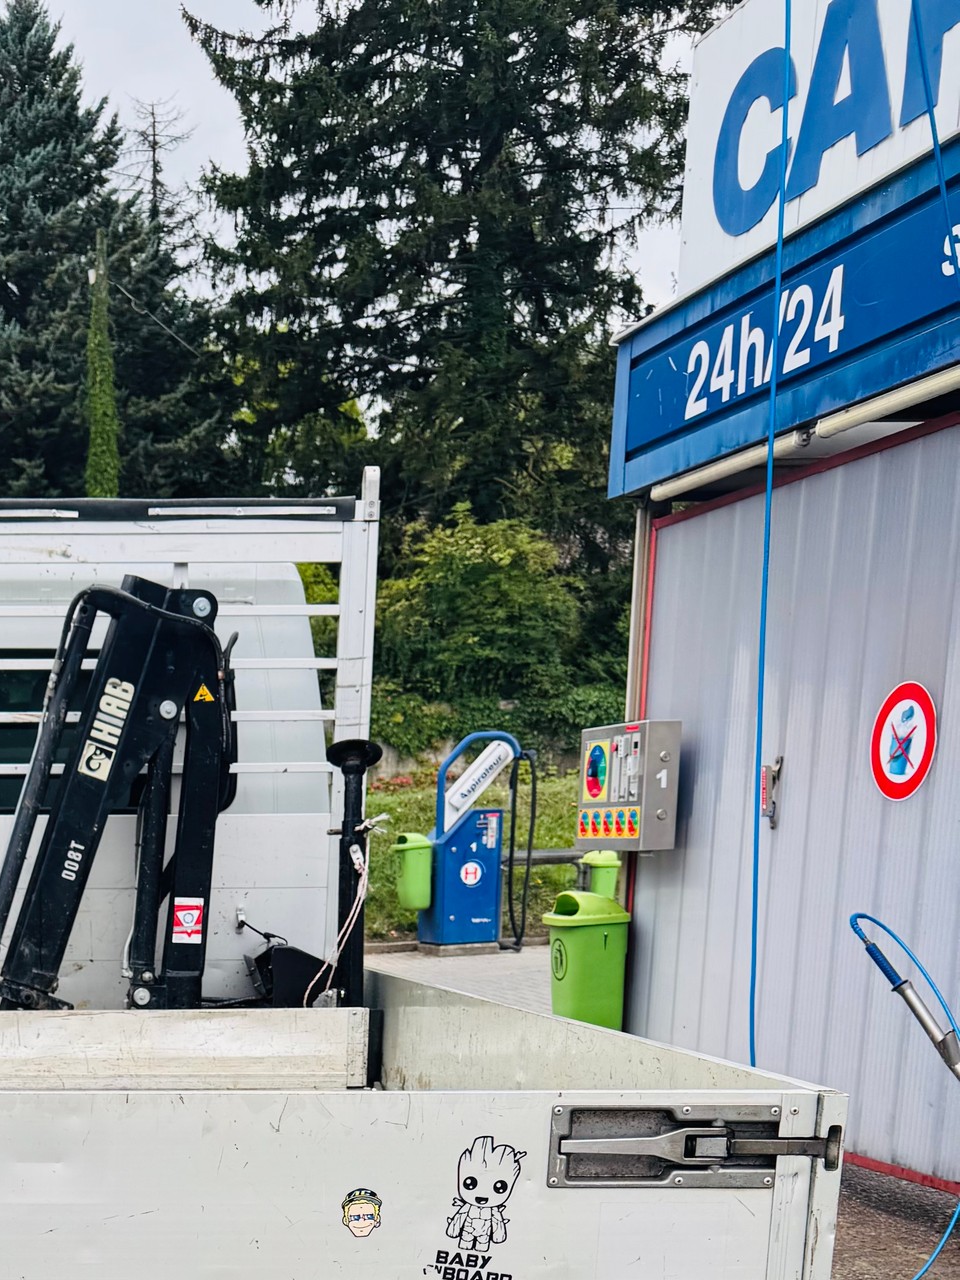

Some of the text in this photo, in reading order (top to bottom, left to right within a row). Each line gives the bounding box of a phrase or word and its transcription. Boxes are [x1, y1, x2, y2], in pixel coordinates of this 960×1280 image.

[684, 264, 845, 421] 24h/24
[90, 677, 135, 745] HIAB
[460, 755, 502, 799] Aspirateur
[656, 769, 667, 788] 1
[61, 839, 85, 881] 008T
[470, 842, 477, 852] 1
[464, 867, 478, 881] H
[436, 1250, 492, 1269] BABY
